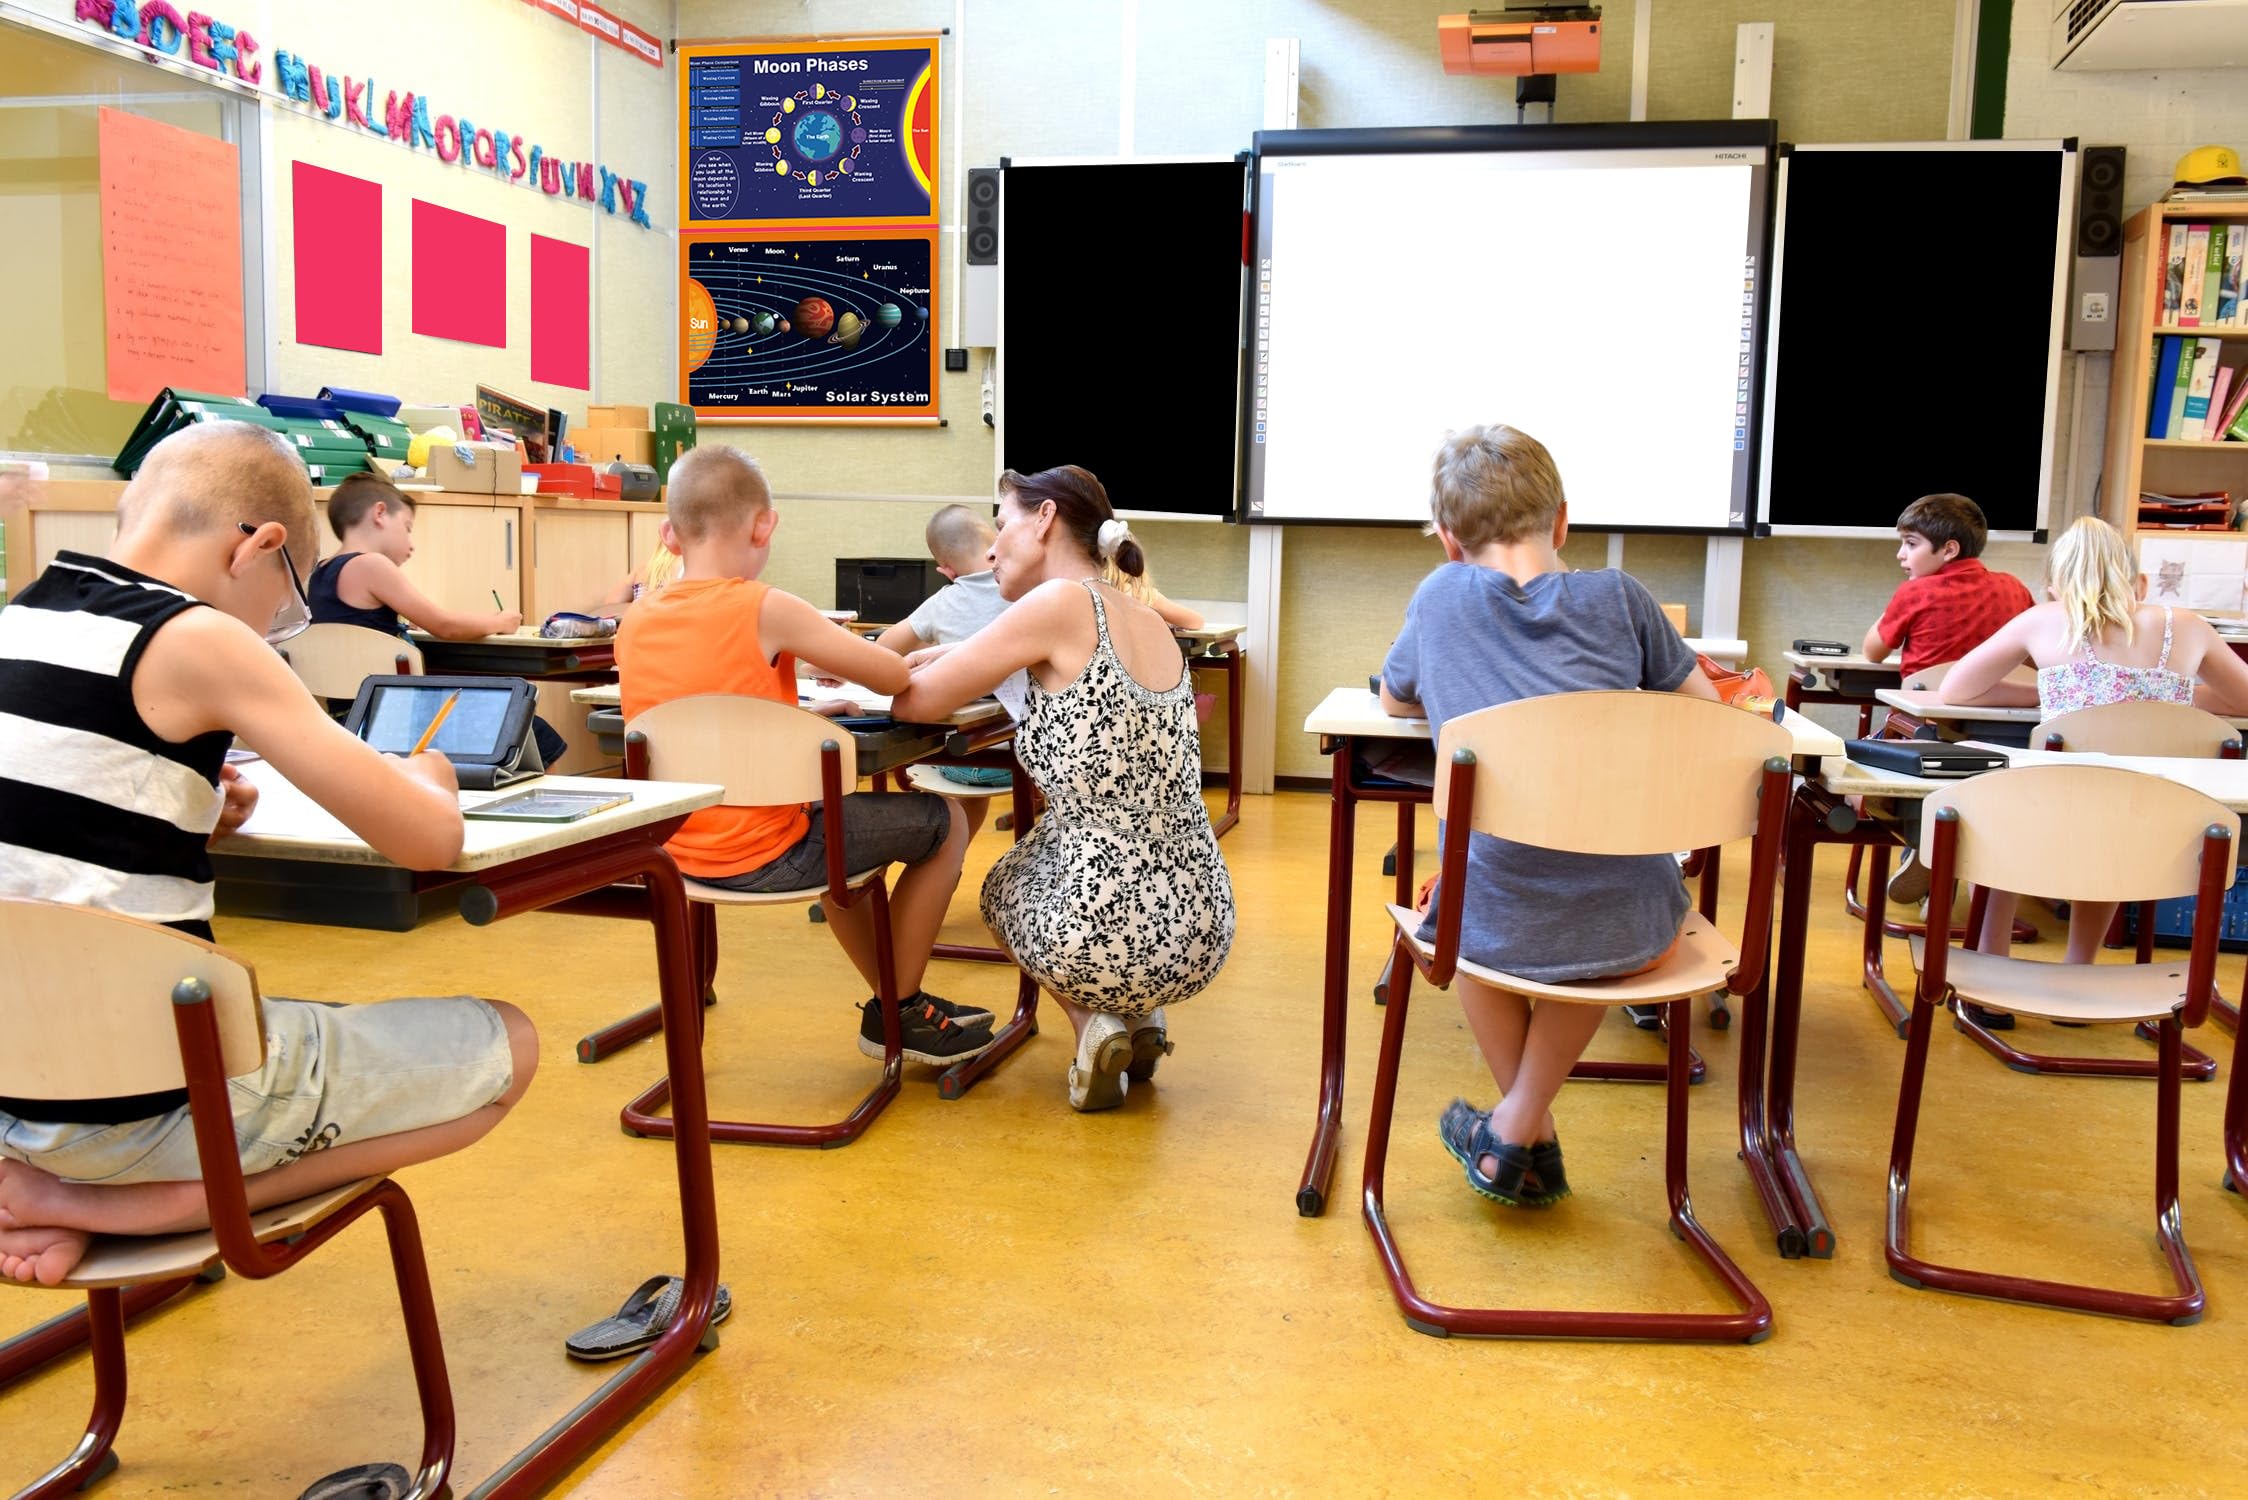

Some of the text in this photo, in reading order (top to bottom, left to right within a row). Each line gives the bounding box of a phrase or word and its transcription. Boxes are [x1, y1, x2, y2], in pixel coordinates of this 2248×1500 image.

[754, 60, 801, 74] Moon
[806, 58, 869, 72] Phases
[690, 317, 709, 329] Sun
[826, 390, 929, 405] Solar System
